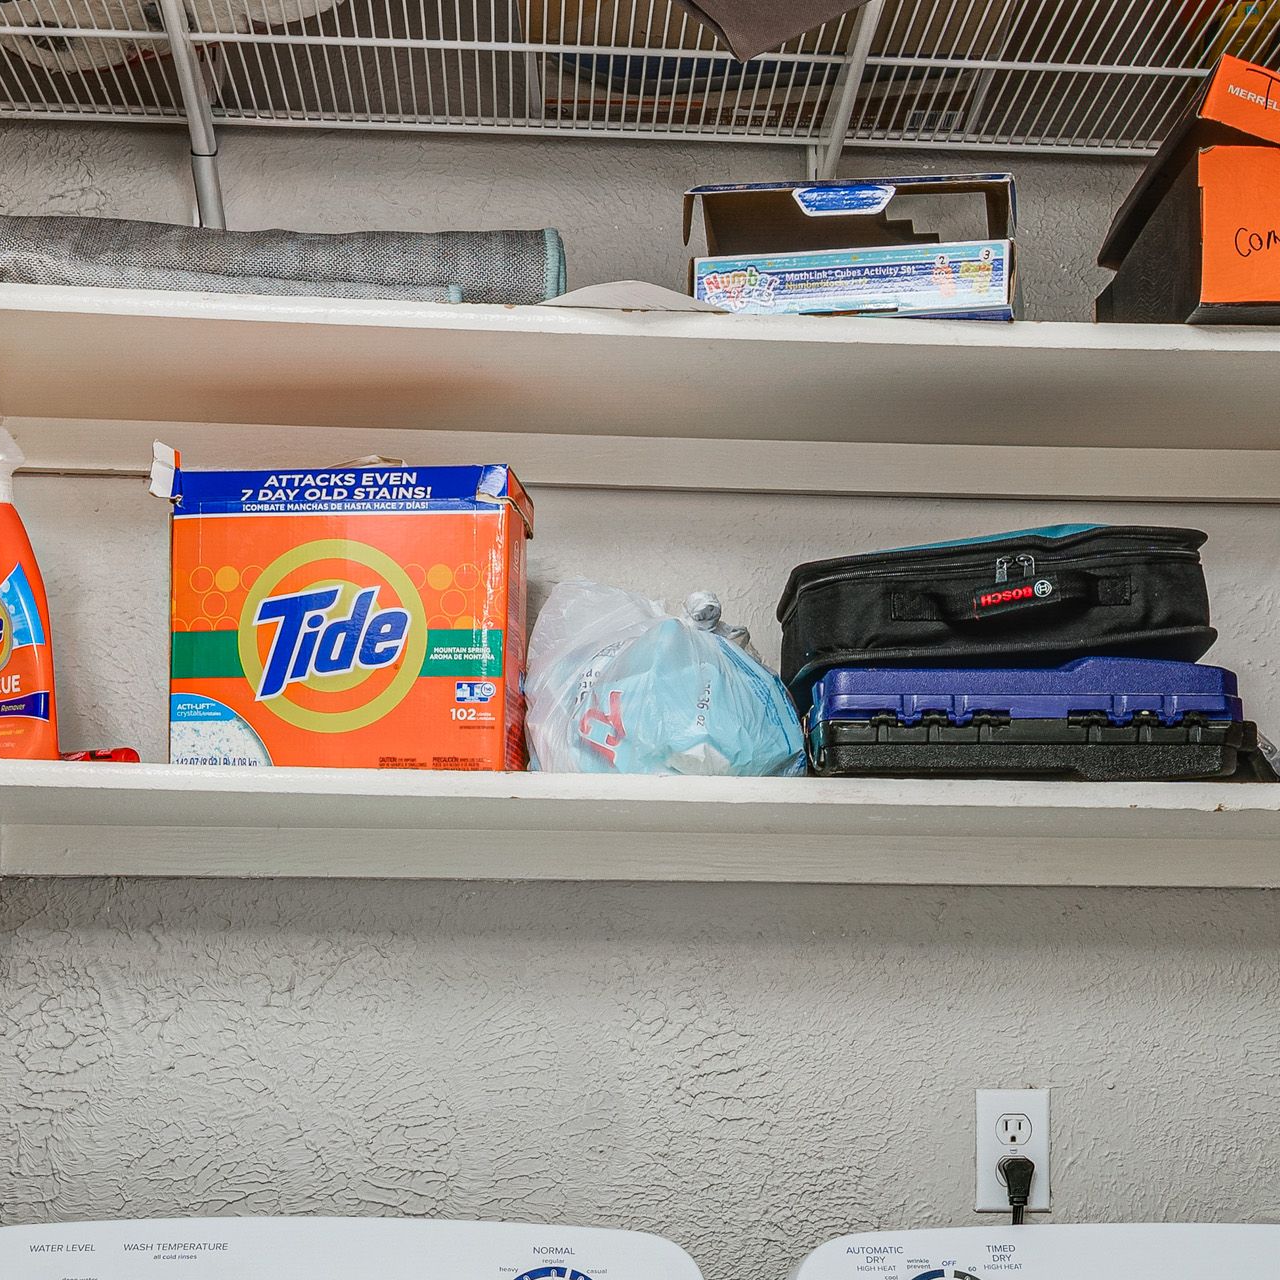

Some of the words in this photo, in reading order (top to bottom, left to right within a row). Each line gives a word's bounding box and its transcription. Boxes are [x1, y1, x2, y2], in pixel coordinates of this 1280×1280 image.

[936, 256, 946, 265] 2
[835, 268, 860, 278] Cubes
[863, 266, 899, 276] Activity
[900, 265, 917, 274] Set
[264, 474, 356, 487] ATTACKS
[361, 472, 417, 486] EVEN
[241, 489, 254, 501] 7
[257, 489, 300, 501] DAY
[304, 488, 348, 500] OLD
[353, 486, 432, 499] STAINS!
[287, 503, 329, 511] MANCHAS
[331, 502, 343, 510] DE
[344, 502, 371, 510] HASTA
[980, 586, 1033, 607] BOSCH
[253, 585, 410, 701] Tide
[1, 704, 26, 712] Remover
[450, 708, 477, 721] 102
[29, 1244, 64, 1252] WATER
[65, 1244, 96, 1252] LEVEL
[123, 1243, 153, 1251] WASH
[157, 1242, 228, 1251] TEMPERATURE
[533, 1246, 575, 1255] NORMAL
[846, 1246, 904, 1254] AUTOMATIC
[992, 1254, 1012, 1262] DRY
